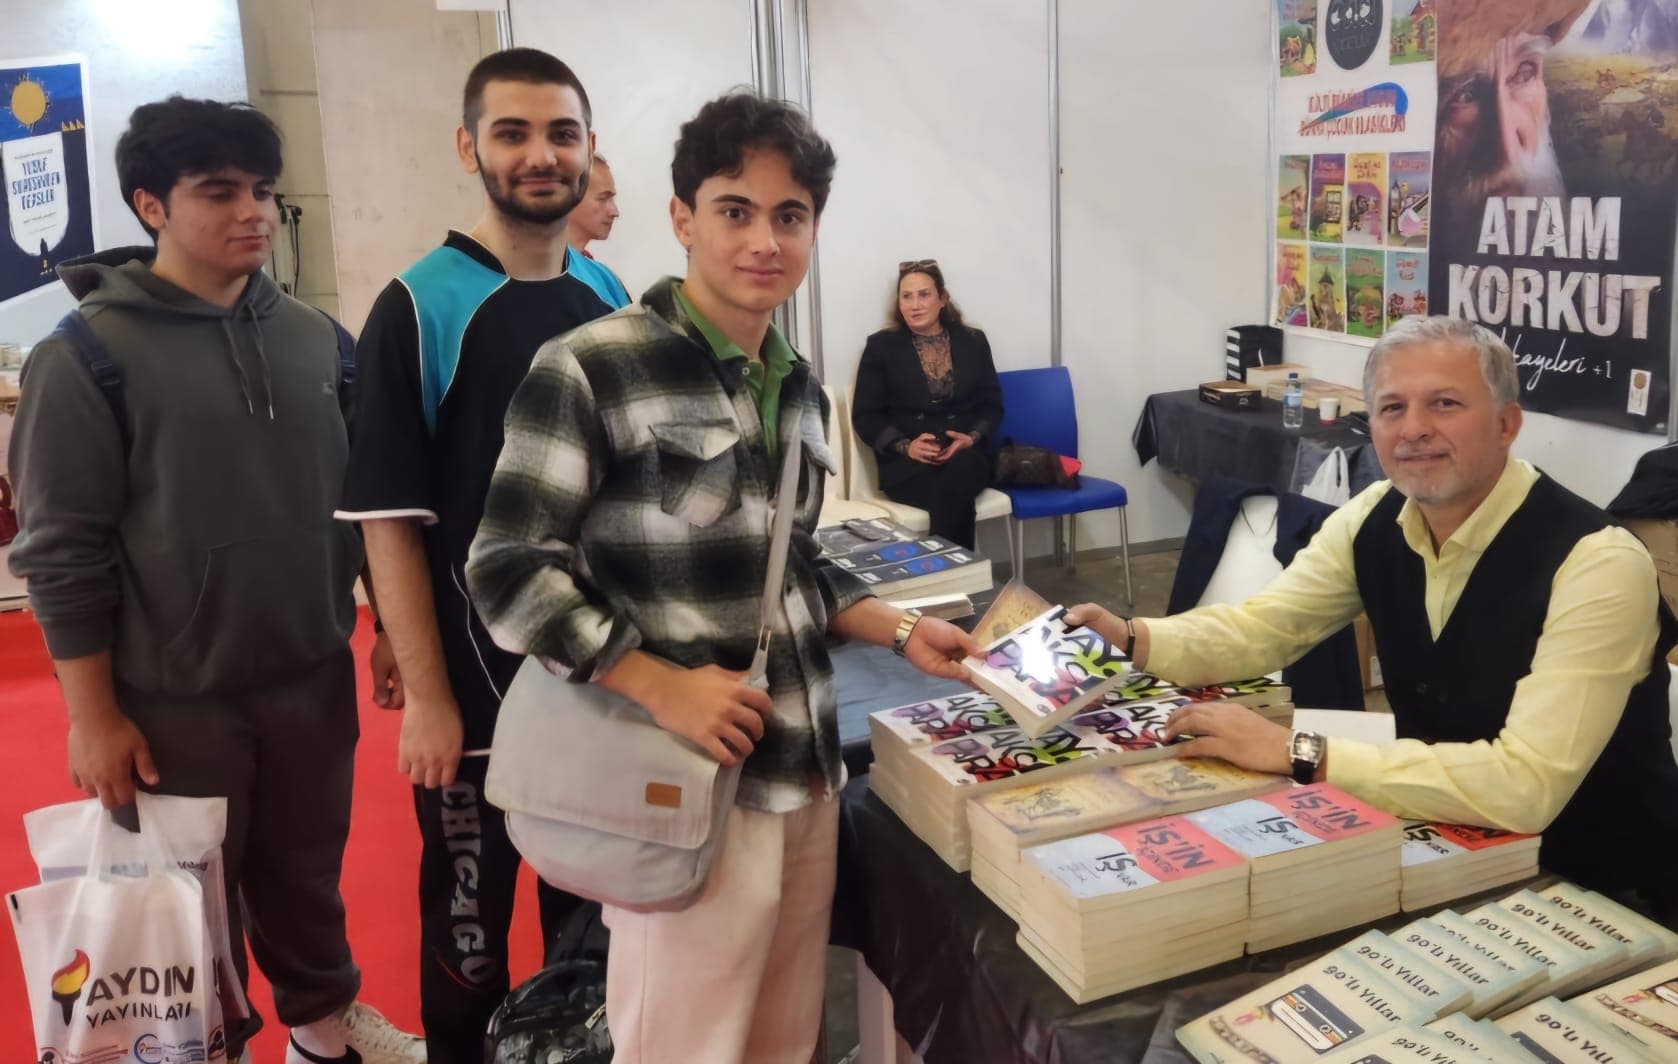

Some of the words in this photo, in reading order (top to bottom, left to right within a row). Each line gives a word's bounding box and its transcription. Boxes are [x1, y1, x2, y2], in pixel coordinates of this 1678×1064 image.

[1477, 196, 1622, 261] ATAM
[1448, 263, 1662, 340] KORKUT
[440, 782, 495, 984] CHICAGO
[1551, 922, 1597, 951] Yıllar
[1587, 916, 1633, 945] Yıllar
[1514, 937, 1558, 968] Yıllar
[86, 965, 195, 1007] AYDIN
[1395, 966, 1440, 998] Yıllar
[1444, 954, 1489, 985] Yıllar
[1360, 988, 1402, 1023] Yıllar
